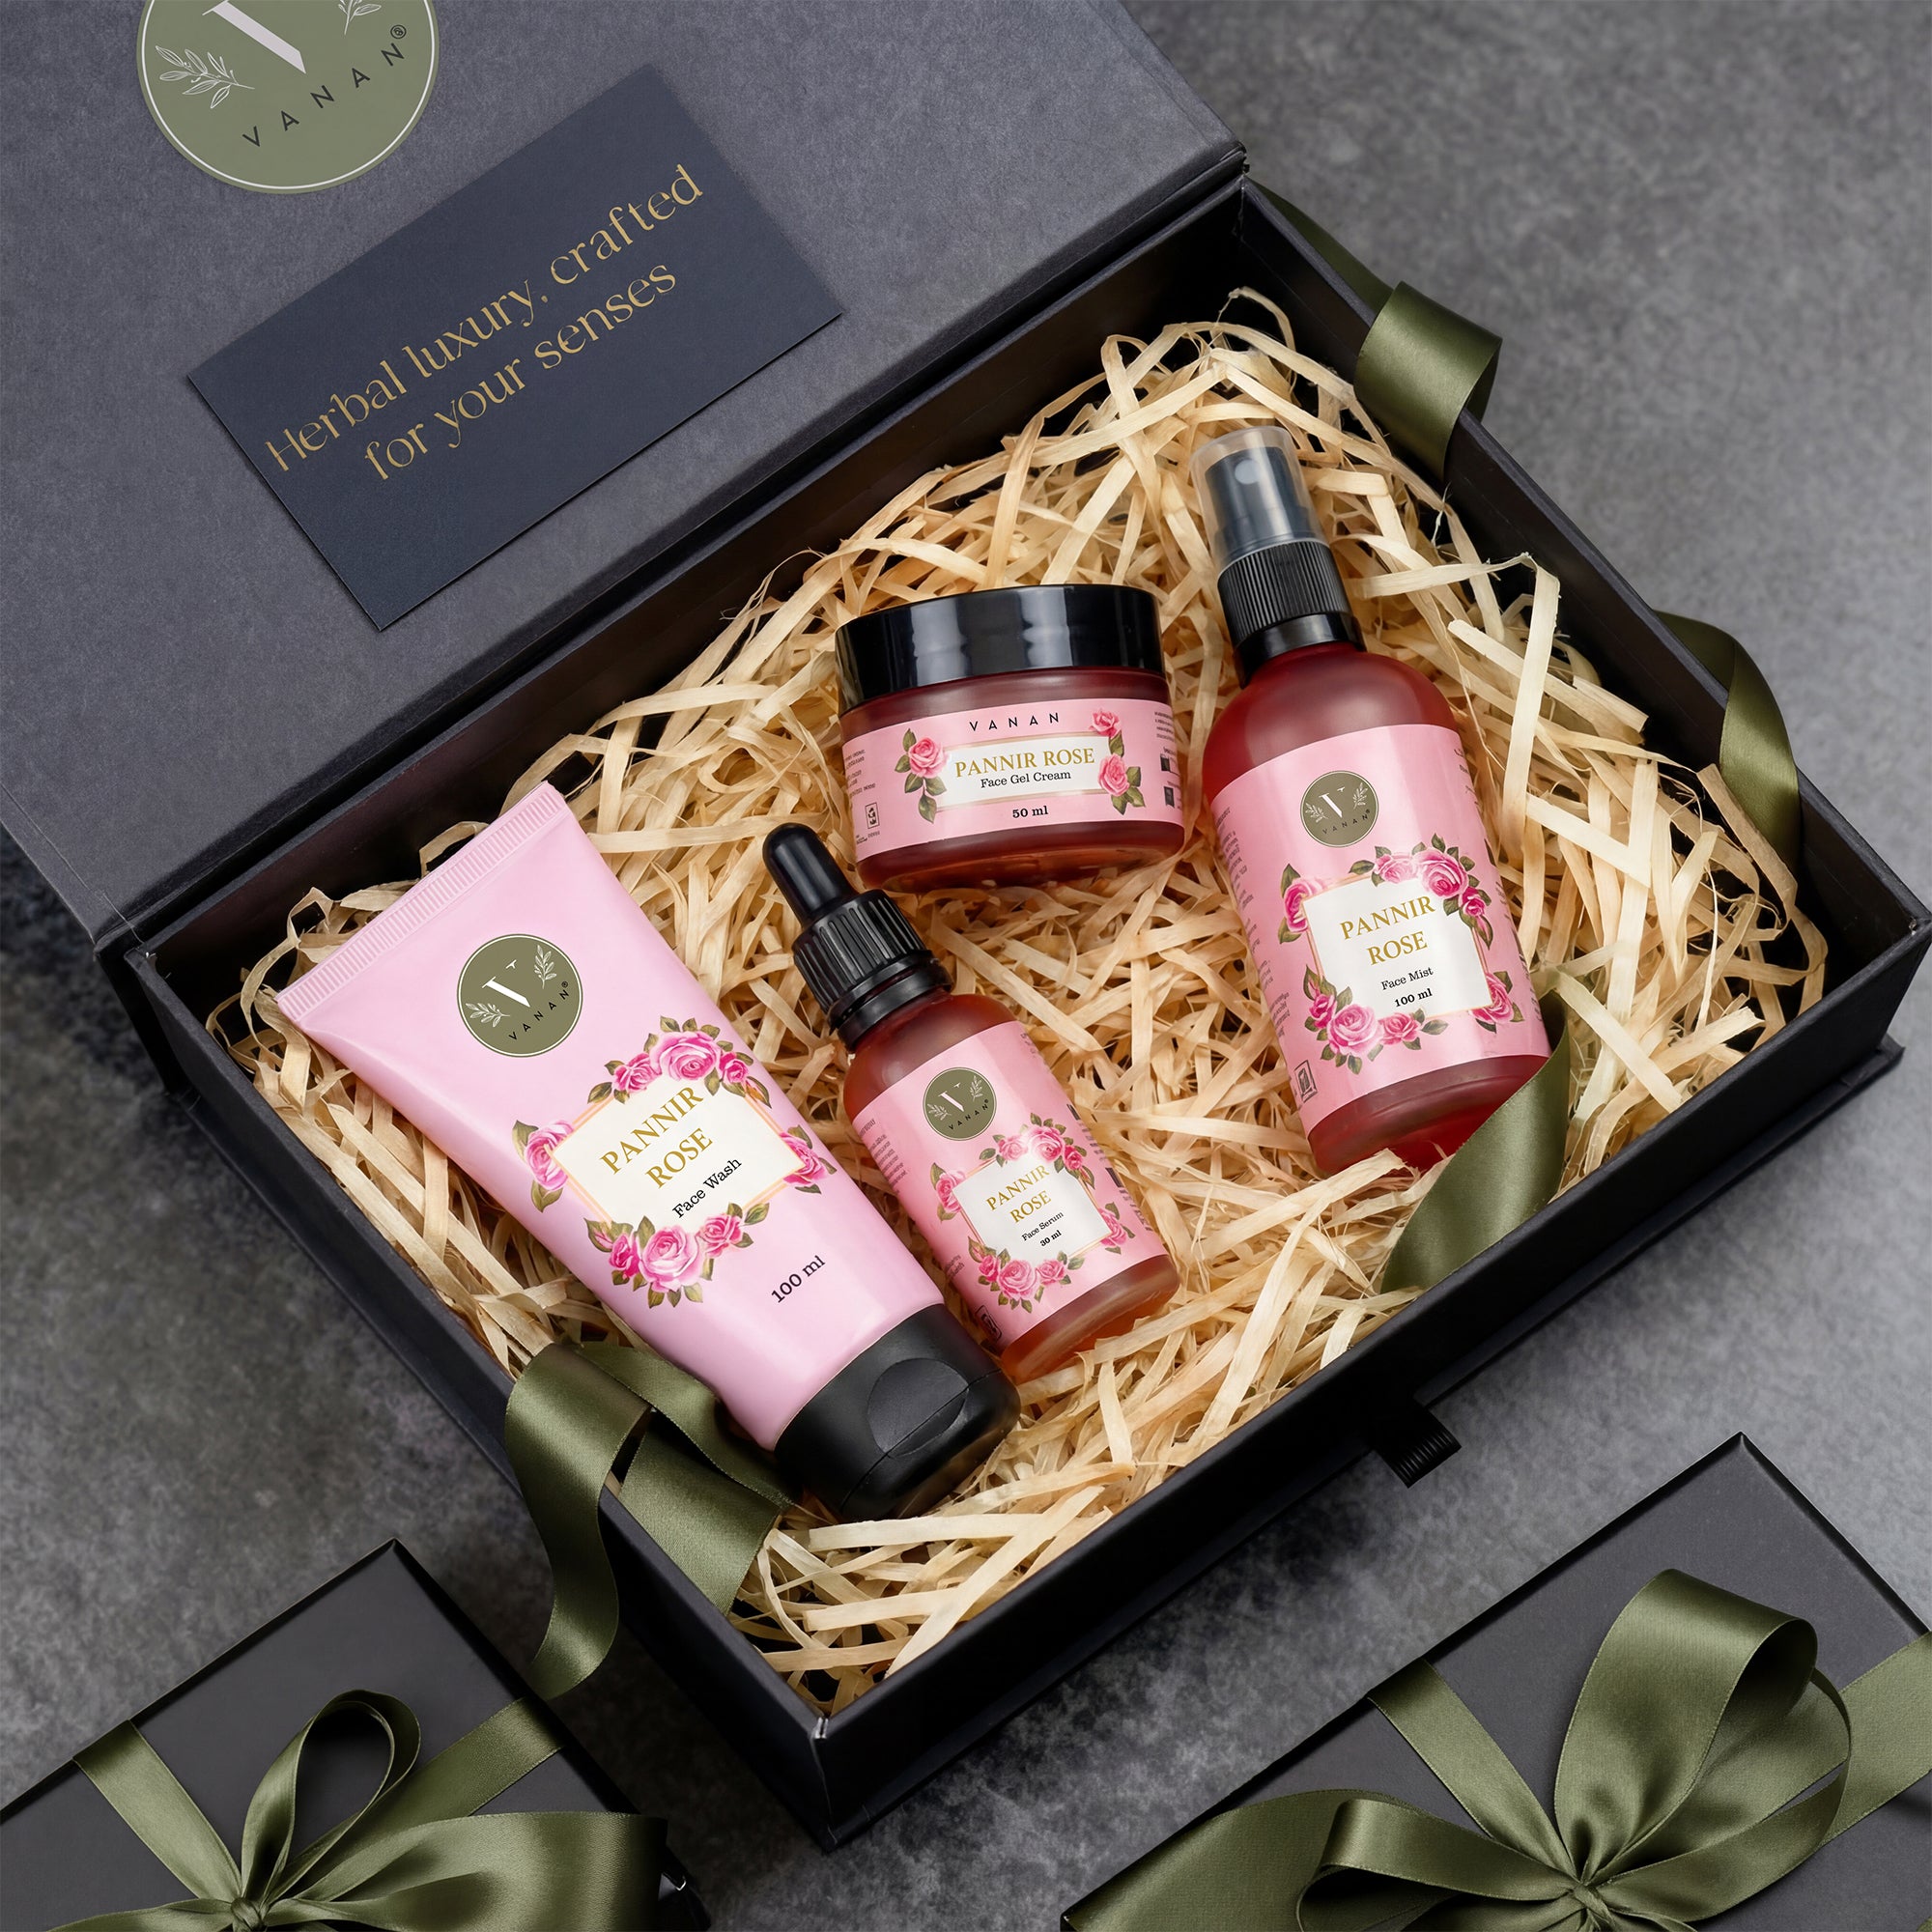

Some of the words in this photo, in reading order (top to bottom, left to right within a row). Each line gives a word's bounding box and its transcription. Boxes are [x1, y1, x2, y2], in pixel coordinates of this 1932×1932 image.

[264, 360, 408, 473] Herbal
[402, 278, 551, 379] luxury,
[549, 163, 703, 286] crafted
[363, 420, 432, 482] for
[434, 360, 526, 449] your
[534, 261, 678, 371] senses
[969, 712, 1060, 732] VANAN
[954, 751, 1037, 779] PANNIR
[1043, 747, 1095, 767] ROSE
[980, 776, 1008, 788] Face
[1009, 772, 1031, 785] Gel
[1033, 770, 1071, 783] Cream
[1011, 807, 1030, 819] 50
[1032, 805, 1049, 817] ml
[1339, 895, 1436, 941] PANNIR
[1365, 930, 1429, 967] ROSE
[1380, 976, 1406, 992] Face
[1407, 966, 1435, 985] Mist
[1394, 992, 1416, 1008] 100
[1418, 987, 1434, 1002] ml
[599, 1085, 705, 1174] PANNIR
[644, 1127, 714, 1189] ROSE
[671, 1187, 707, 1219] Face
[702, 1156, 743, 1192] Wash
[985, 1164, 1052, 1211] PANNIR
[1010, 1189, 1053, 1224] ROSE
[1021, 1225, 1041, 1242] Face
[1038, 1210, 1065, 1232] Serum
[1039, 1236, 1052, 1248] 30
[1050, 1230, 1063, 1242] ml
[770, 1271, 803, 1304] 100
[801, 1254, 827, 1278] ml
